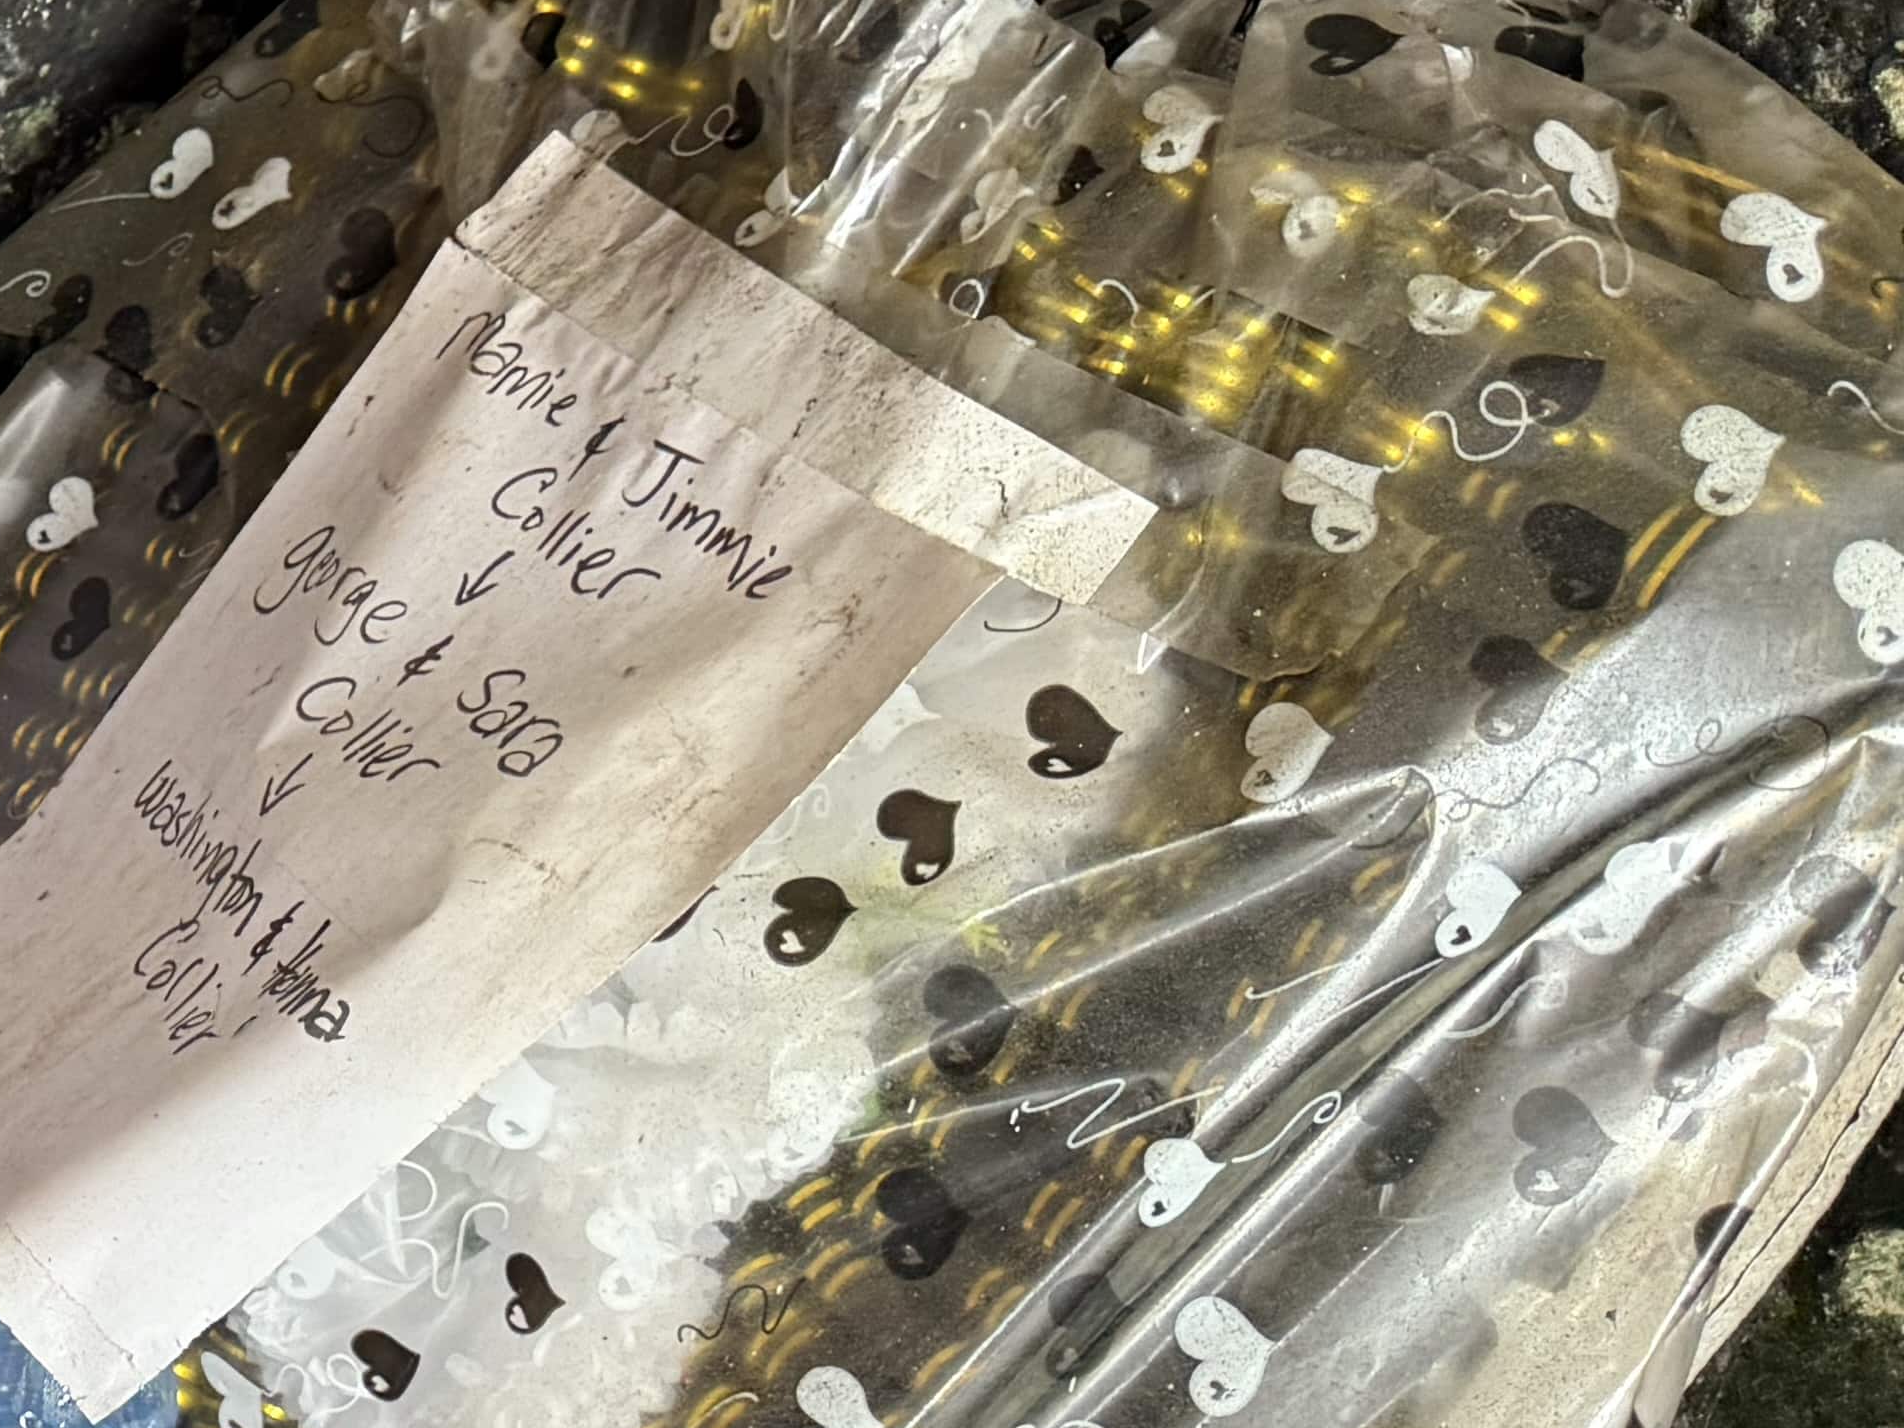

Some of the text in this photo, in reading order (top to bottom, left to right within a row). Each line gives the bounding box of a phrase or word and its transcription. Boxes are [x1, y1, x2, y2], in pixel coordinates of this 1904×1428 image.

[437, 311, 577, 427] Mamie
[622, 439, 793, 600] Jimmie
[491, 467, 661, 600] Collier
[295, 676, 441, 781] Collier
[457, 669, 564, 777] Sara
[134, 918, 220, 1055] Collier
